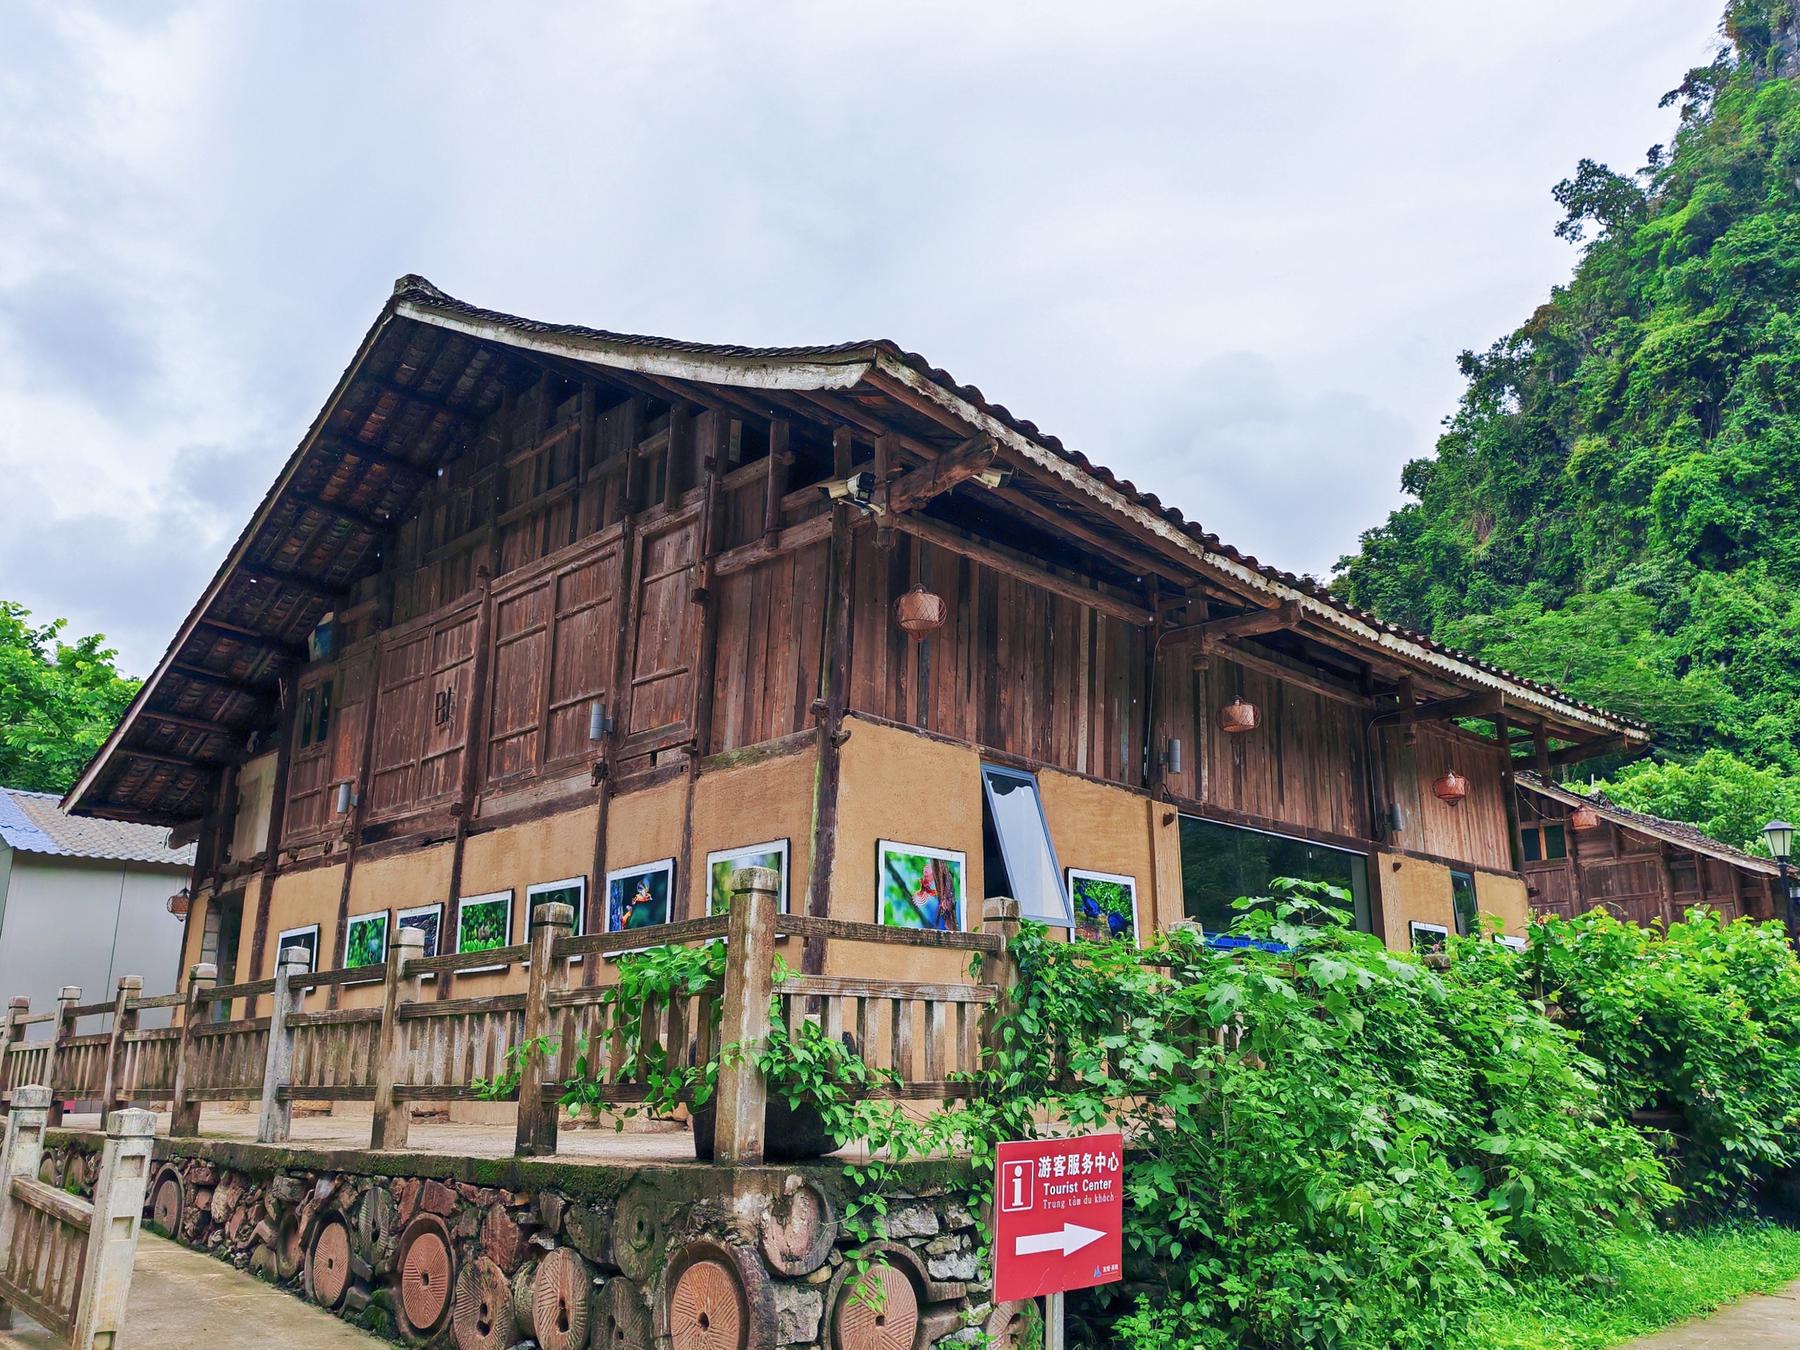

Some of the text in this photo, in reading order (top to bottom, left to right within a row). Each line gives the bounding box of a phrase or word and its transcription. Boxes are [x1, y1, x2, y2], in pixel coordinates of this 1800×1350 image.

[1038, 1152, 1119, 1178] 游客服务中心
[1043, 1179, 1112, 1196] Tourist Center
[1043, 1199, 1065, 1209] Trung
